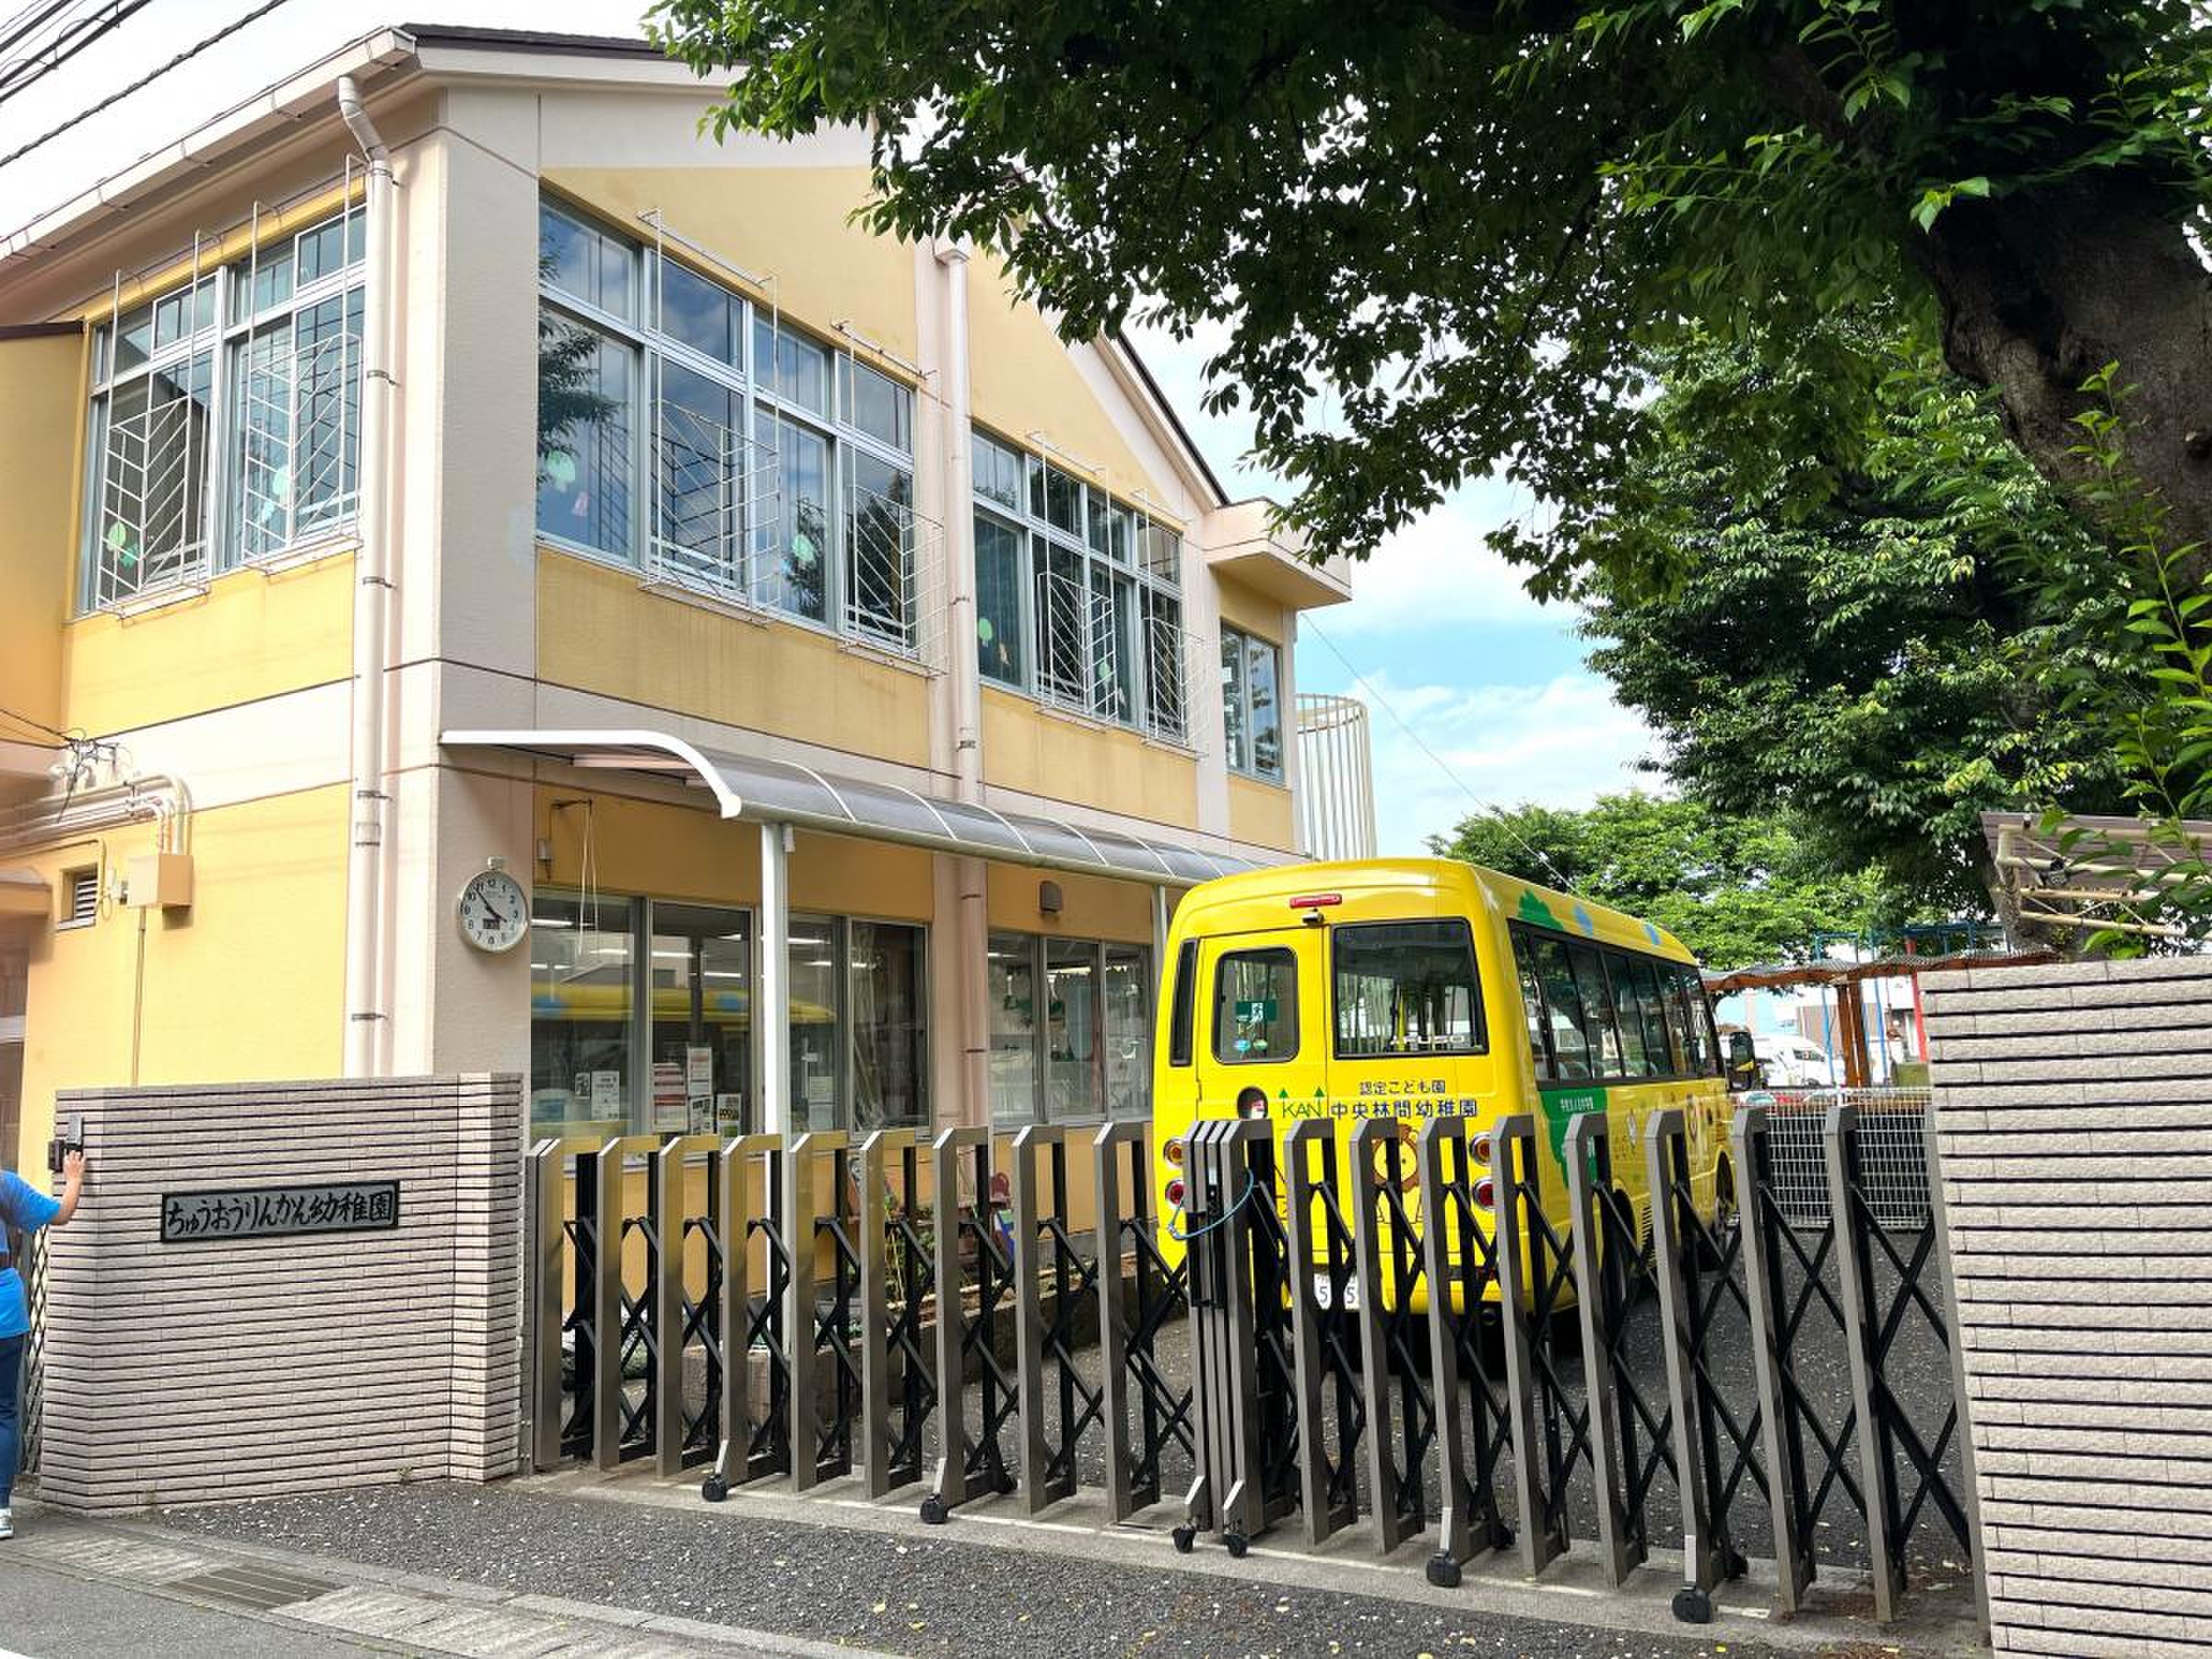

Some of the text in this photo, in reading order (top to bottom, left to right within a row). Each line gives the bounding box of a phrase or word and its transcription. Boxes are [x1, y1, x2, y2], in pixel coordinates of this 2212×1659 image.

[1359, 1079, 1446, 1095] 認定こども園
[1330, 1099, 1477, 1119] 中央林間幼稚園
[167, 1191, 394, 1236] ちゅうおうりんかん幼稚園
